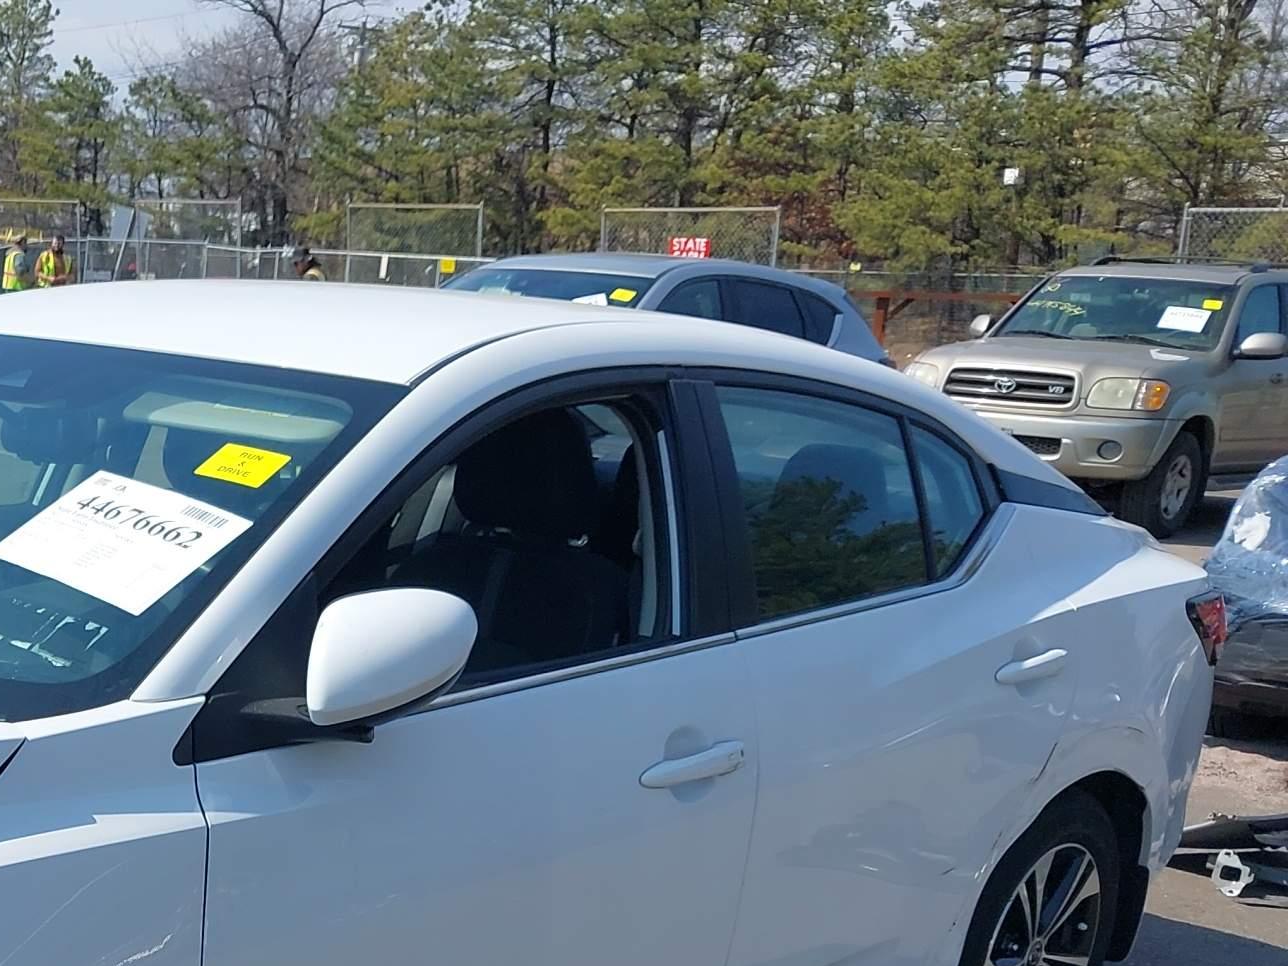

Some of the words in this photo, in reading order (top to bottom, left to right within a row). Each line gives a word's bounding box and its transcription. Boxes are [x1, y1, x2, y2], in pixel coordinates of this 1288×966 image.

[672, 237, 707, 251] STATE
[1048, 384, 1065, 394] V8
[239, 451, 264, 461] RUN
[216, 465, 251, 478] DRIVE
[76, 495, 203, 549] 44676662
